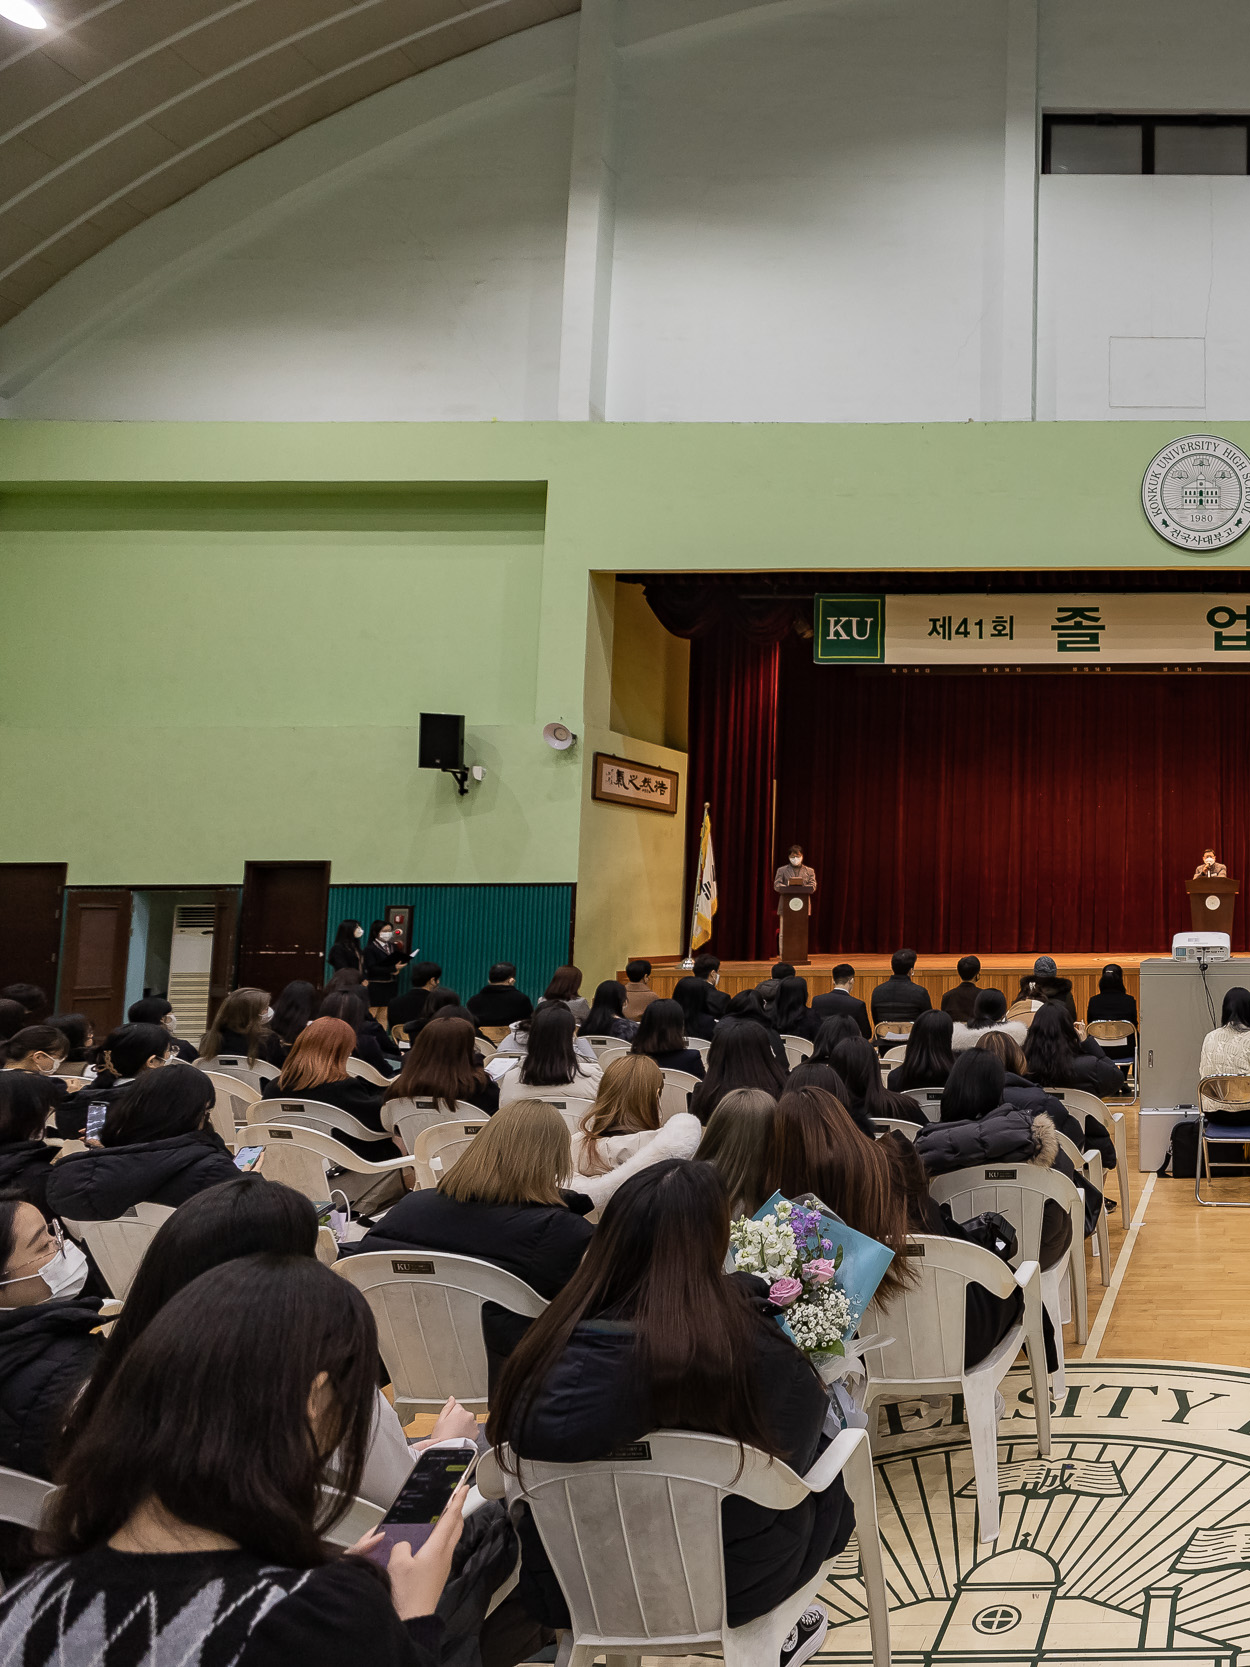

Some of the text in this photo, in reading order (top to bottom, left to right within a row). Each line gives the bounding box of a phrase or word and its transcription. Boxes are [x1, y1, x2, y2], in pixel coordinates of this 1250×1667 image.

[1148, 470, 1162, 517] KONKUK
[1156, 440, 1220, 470] UNIVERSITY
[1222, 447, 1248, 471] HIGH
[1190, 514, 1213, 523] 1980
[1170, 527, 1235, 545] 건국사대부고
[825, 616, 874, 641] KU
[927, 615, 1015, 641] 제41회
[397, 1263, 411, 1271] KU
